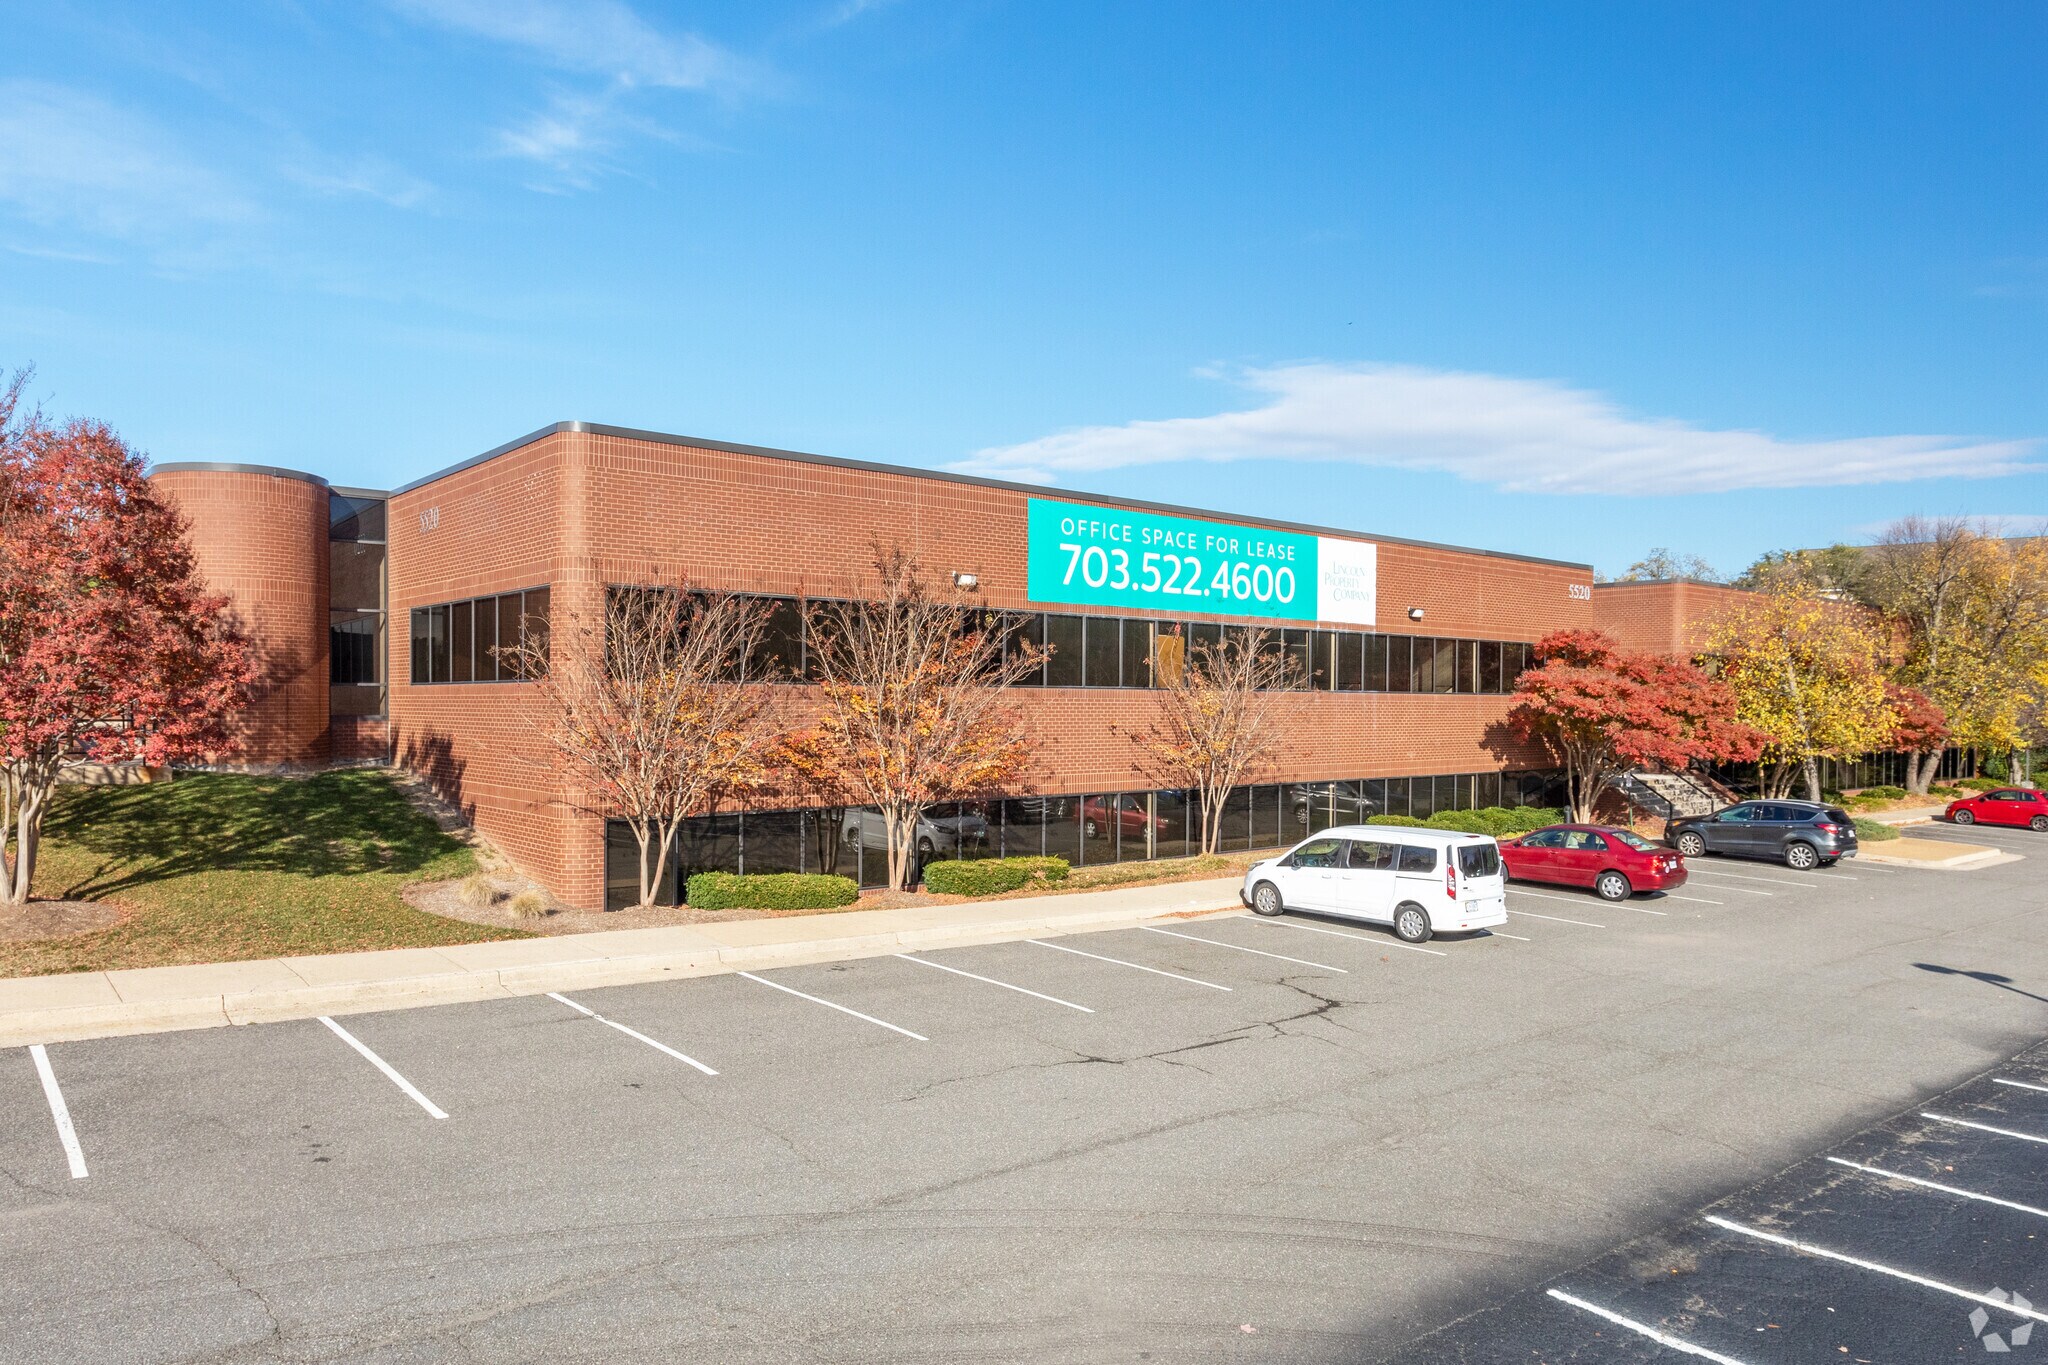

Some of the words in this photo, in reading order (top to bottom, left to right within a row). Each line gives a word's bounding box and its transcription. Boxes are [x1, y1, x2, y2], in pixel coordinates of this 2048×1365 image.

[420, 506, 439, 532] 5520
[1060, 517, 1132, 543] OFFICE
[1141, 527, 1197, 550] SPACE
[1206, 535, 1239, 555] FOR
[1247, 541, 1295, 561] LEASE
[1059, 542, 1296, 604] 703.522.4600
[1569, 584, 1590, 600] 5520
